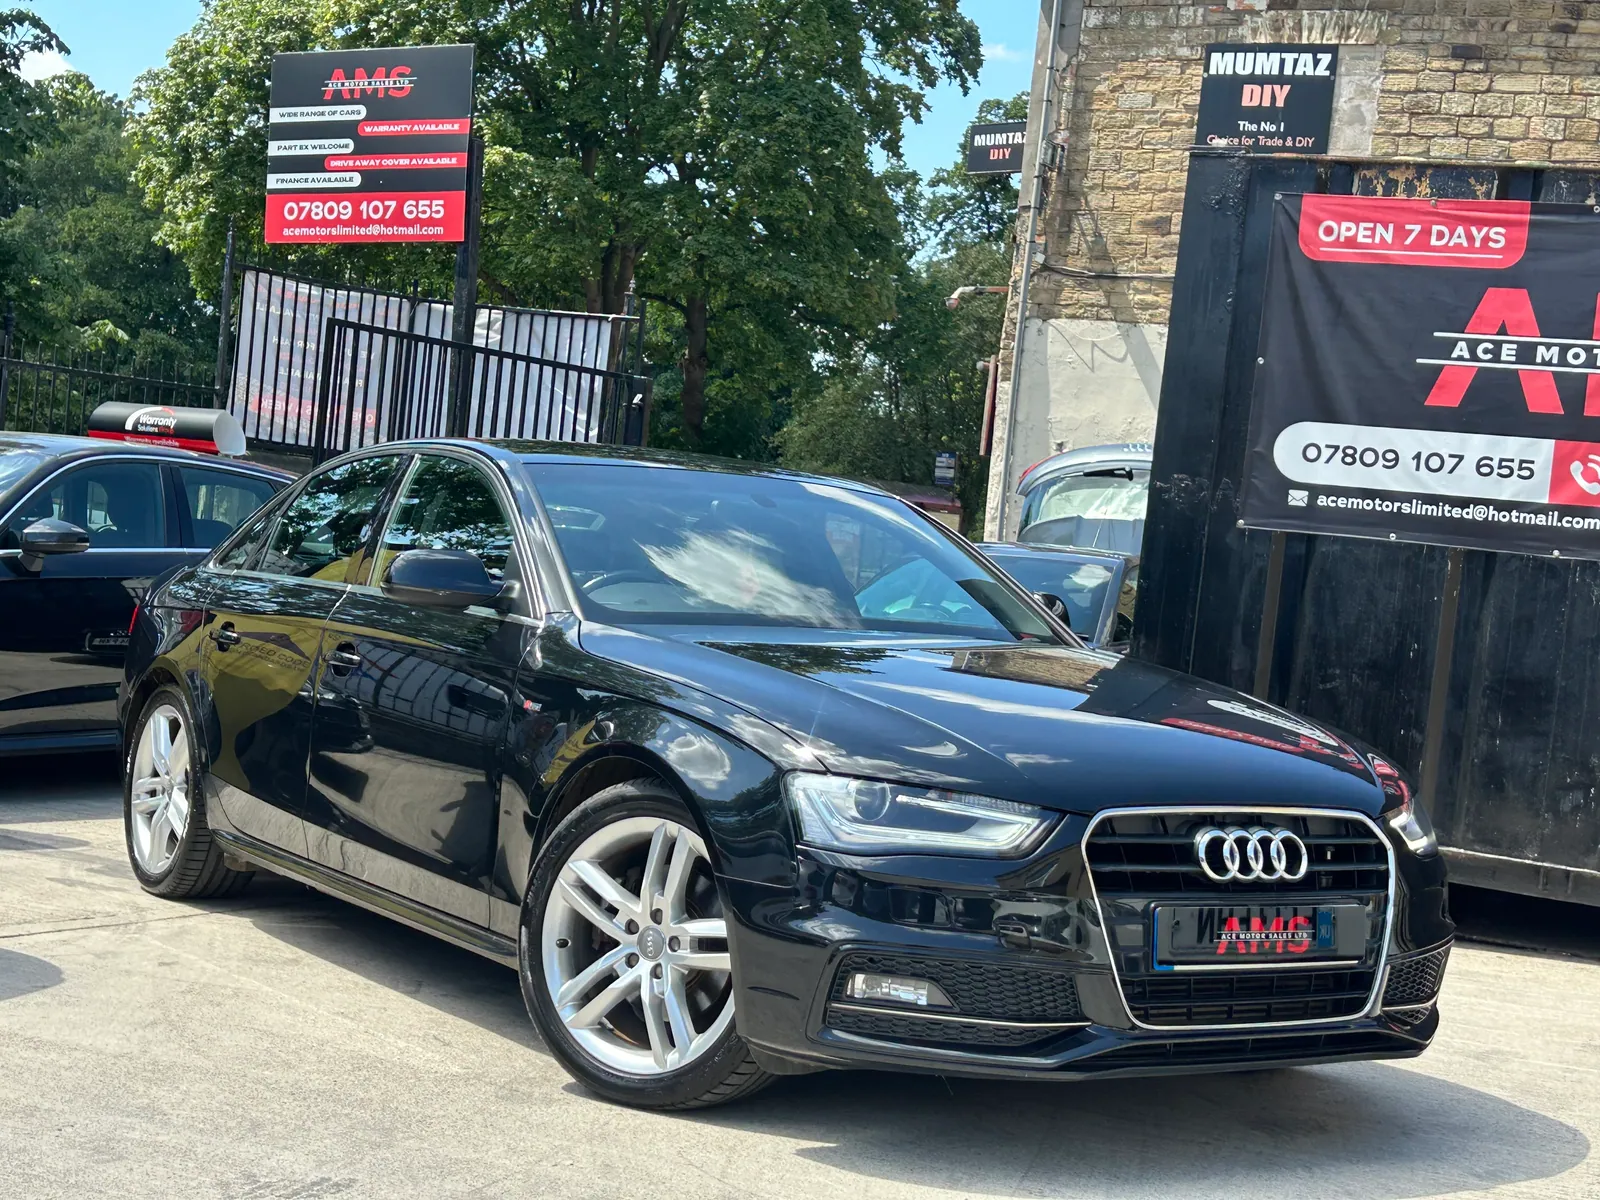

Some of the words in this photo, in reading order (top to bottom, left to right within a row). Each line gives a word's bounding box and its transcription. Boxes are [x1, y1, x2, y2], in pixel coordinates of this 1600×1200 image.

[1209, 52, 1332, 76] MUMTAZ
[323, 65, 411, 100] AMS
[1241, 84, 1291, 107] DIY
[364, 124, 412, 133] WARRANTY
[413, 123, 459, 131] AVAILABLE
[1237, 121, 1257, 132] The
[1260, 121, 1276, 132] No
[1241, 135, 1256, 146] for
[1257, 135, 1282, 147] Trade
[1285, 136, 1293, 147] &
[1295, 136, 1315, 147] DIY
[330, 159, 353, 167] DRIVE
[381, 158, 409, 166] COVER
[411, 157, 457, 165] AVAILABLE
[989, 147, 1011, 160] DIY
[310, 176, 354, 184] AVAILABLE
[283, 200, 352, 221] 07809
[359, 200, 397, 220] 107
[403, 199, 444, 219] 655
[283, 223, 444, 236] acemotorslimited@hotmail.com
[1318, 220, 1394, 245] OPEN
[1403, 224, 1422, 245] 7
[1430, 224, 1506, 249] DAYS
[1451, 340, 1518, 362] ACE
[139, 414, 177, 429] Warranty
[1301, 442, 1400, 470] 07809
[1411, 450, 1465, 475] 107
[1474, 455, 1536, 481] 655
[1316, 491, 1600, 531] acemotorslimited@hotmail.com
[1216, 916, 1310, 955] AMS
[1221, 932, 1236, 940] ACE
[1239, 932, 1266, 940] MOTOR
[1294, 931, 1308, 939] LTD
